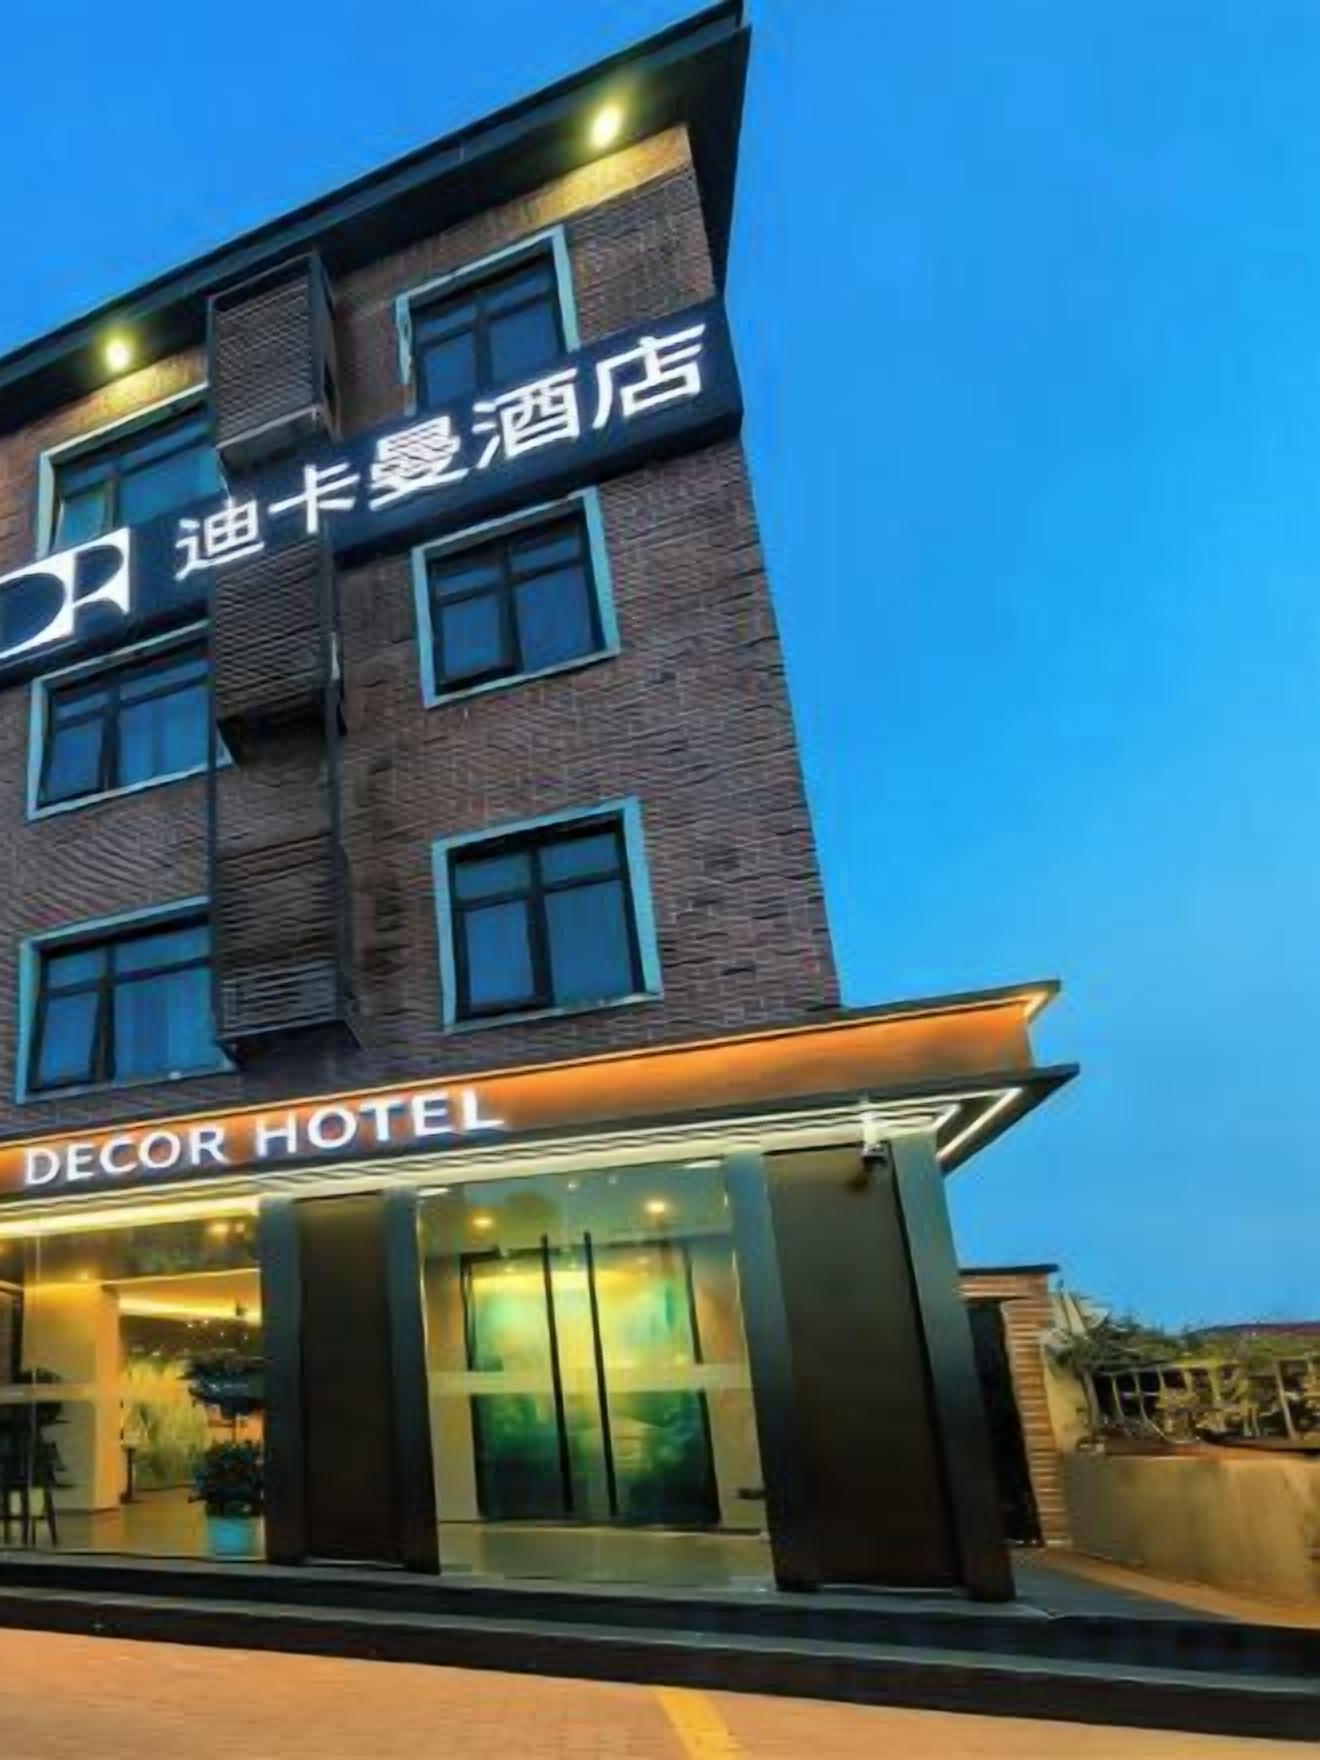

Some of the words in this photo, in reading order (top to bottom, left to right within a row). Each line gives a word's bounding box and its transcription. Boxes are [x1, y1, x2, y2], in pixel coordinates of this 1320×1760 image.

[175, 322, 708, 582] 迪卡曼酒店
[23, 1123, 231, 1188] DECOR
[254, 1088, 505, 1157] HOTEL
